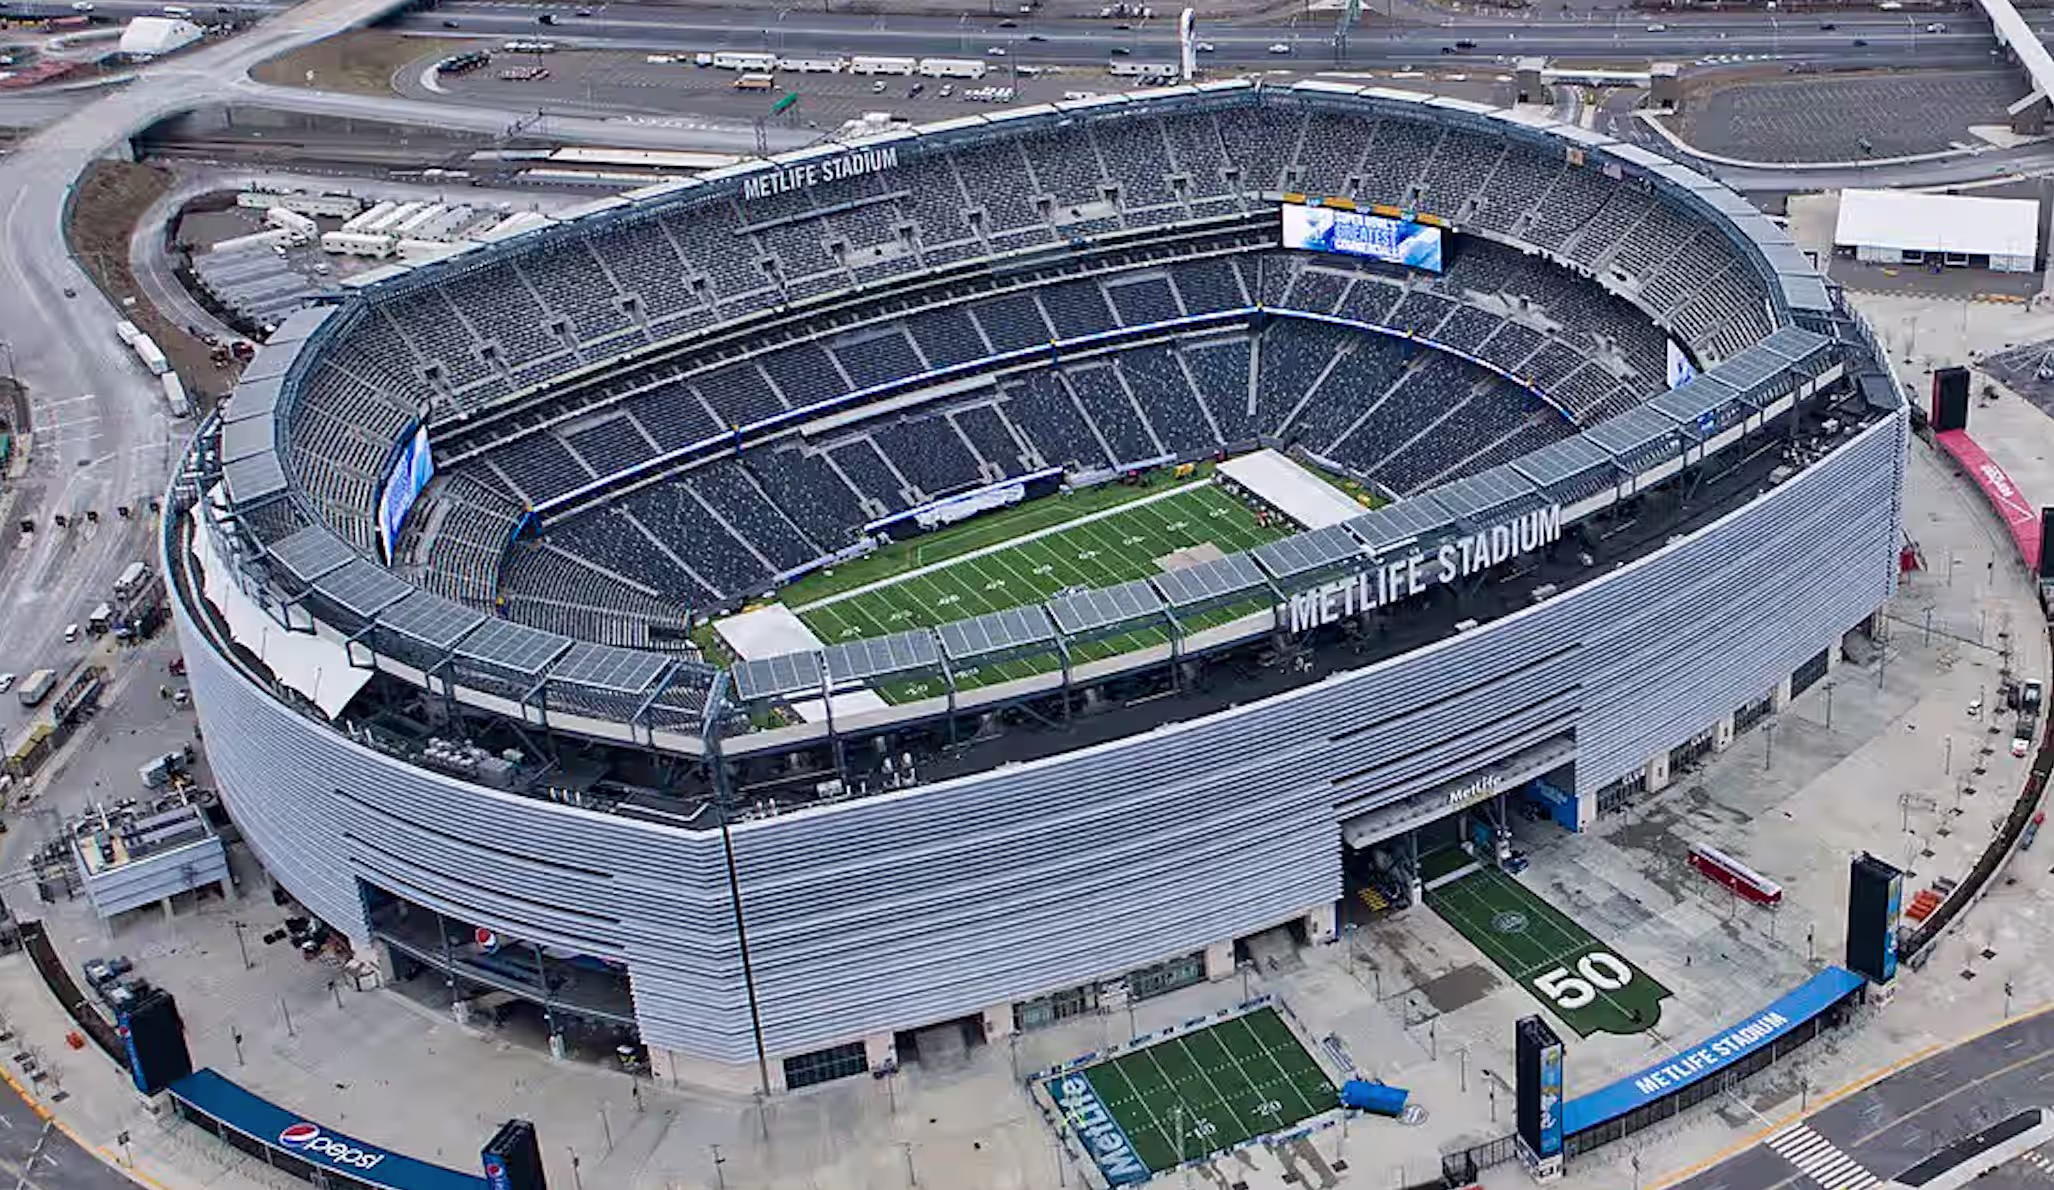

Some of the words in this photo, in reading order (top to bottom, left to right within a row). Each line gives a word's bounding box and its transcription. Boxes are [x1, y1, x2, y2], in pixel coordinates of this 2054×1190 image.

[744, 164, 818, 200] METLIFE
[822, 147, 898, 182] STADIUM
[1290, 556, 1426, 633] METLIFE
[1438, 503, 1561, 583] STADIUM
[1450, 775, 1501, 802] MetLife
[1533, 952, 1633, 1009] 50
[1634, 1048, 1719, 1095] METLIFE
[1711, 1011, 1789, 1057] STADIUM
[303, 1136, 385, 1169] pepsi
[1059, 1077, 1145, 1176] MetLife
